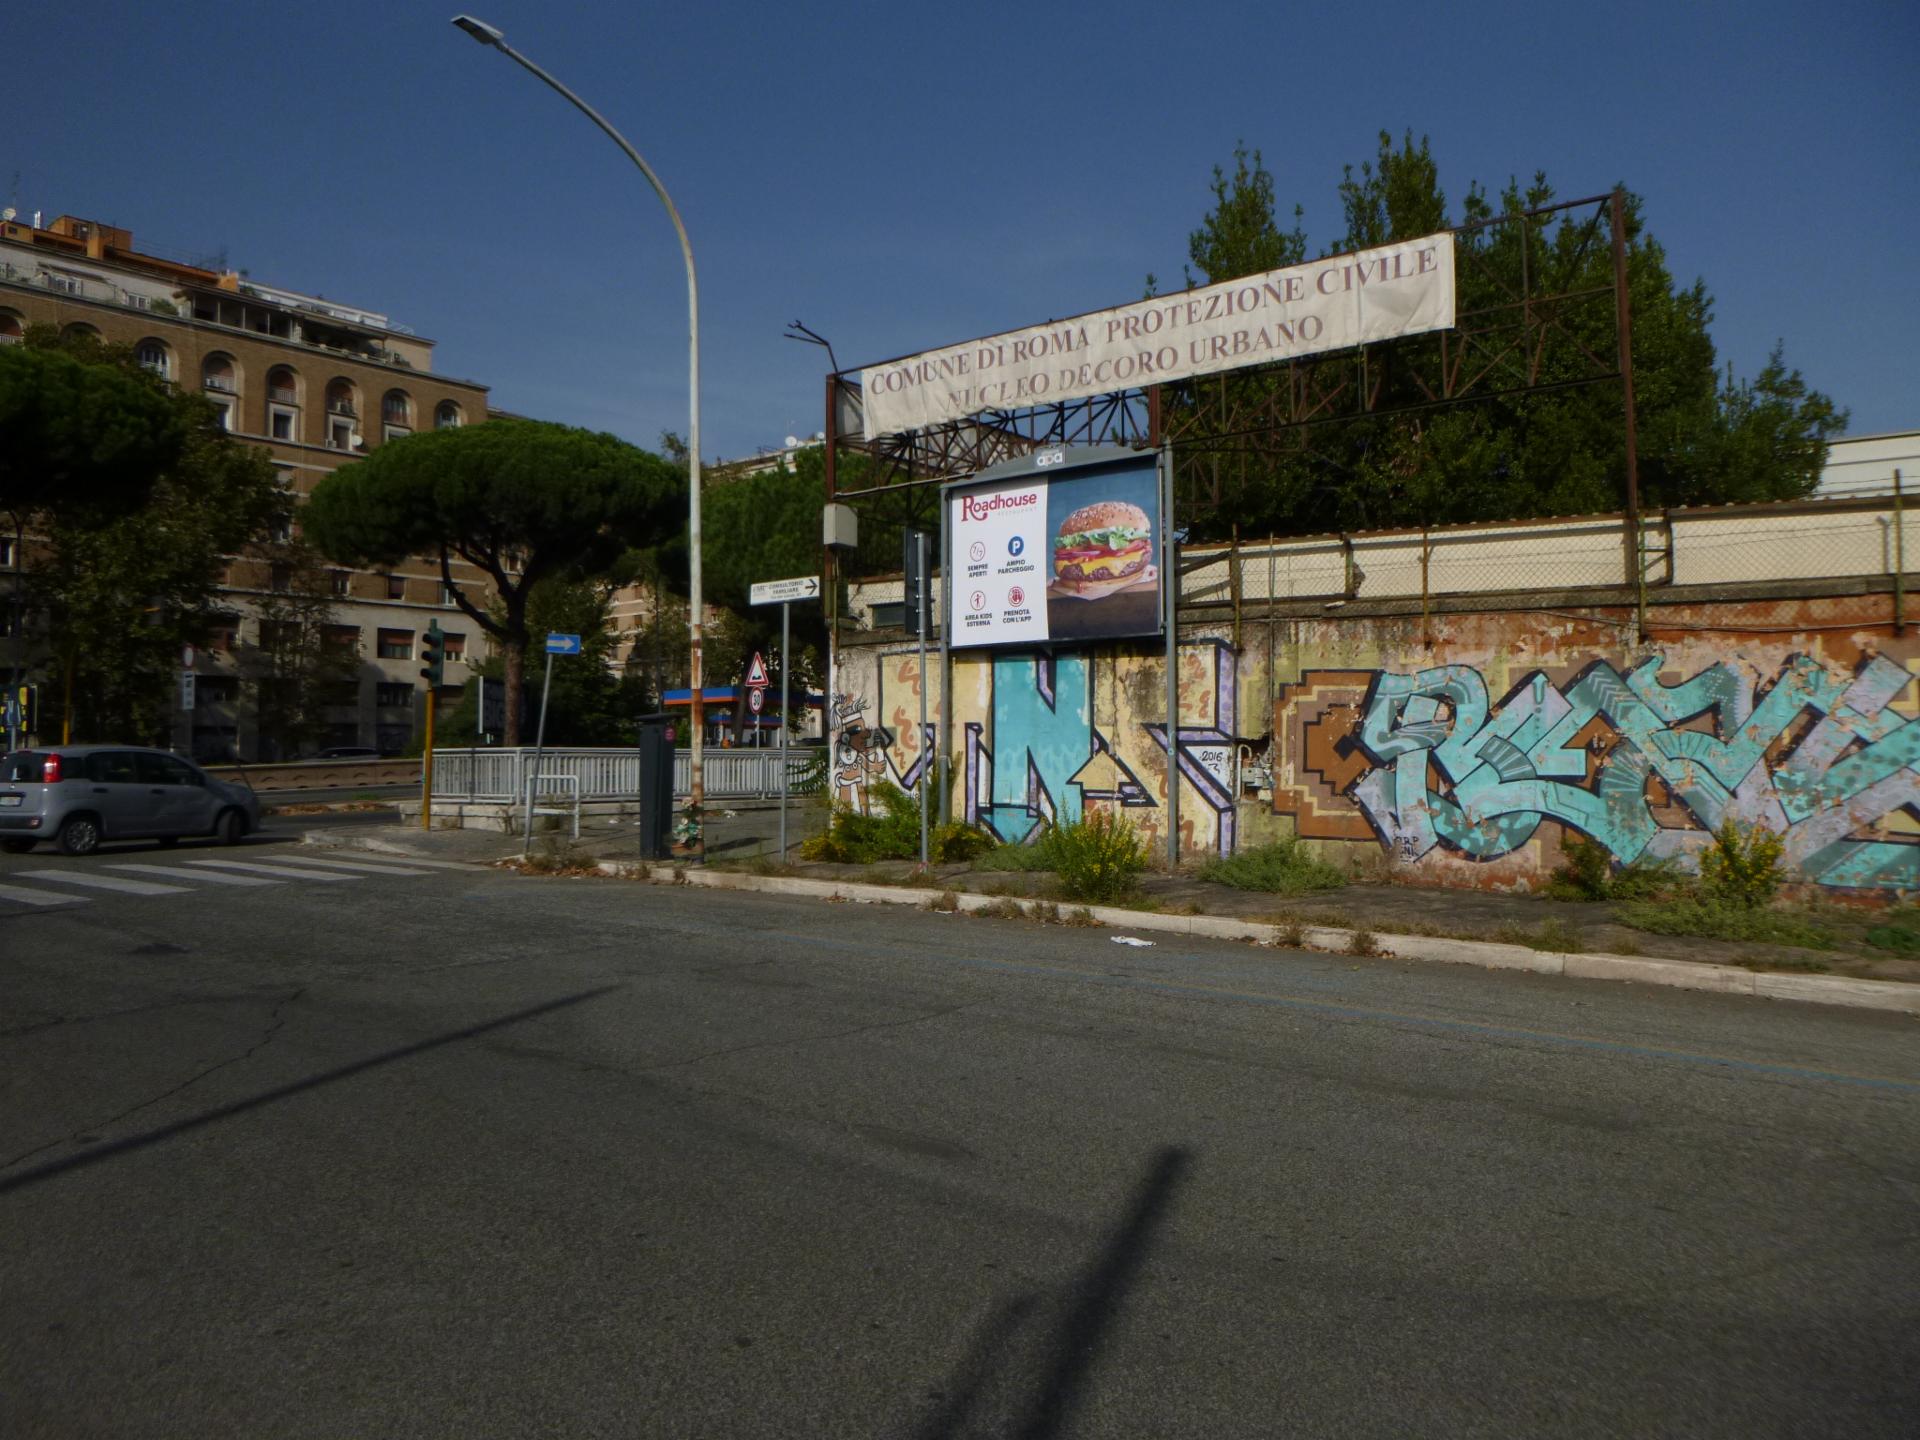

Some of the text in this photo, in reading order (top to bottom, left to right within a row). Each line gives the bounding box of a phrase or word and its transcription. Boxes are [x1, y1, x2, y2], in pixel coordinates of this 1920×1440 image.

[871, 246, 1438, 395] COMUNE DI ROMA PROTEZIONE CIVILE
[947, 315, 1323, 410] NUCLEO DECORO URBANO
[961, 494, 1037, 522] Roadhouse
[968, 564, 988, 572] SEMPRE
[1006, 560, 1026, 568] AMPIO
[968, 570, 988, 578] APERTI
[998, 566, 1034, 574] PARCHEGGIO
[1004, 608, 1030, 616] PRENOTA
[966, 620, 990, 628] ESTERNA
[1201, 750, 1223, 762] 2016
